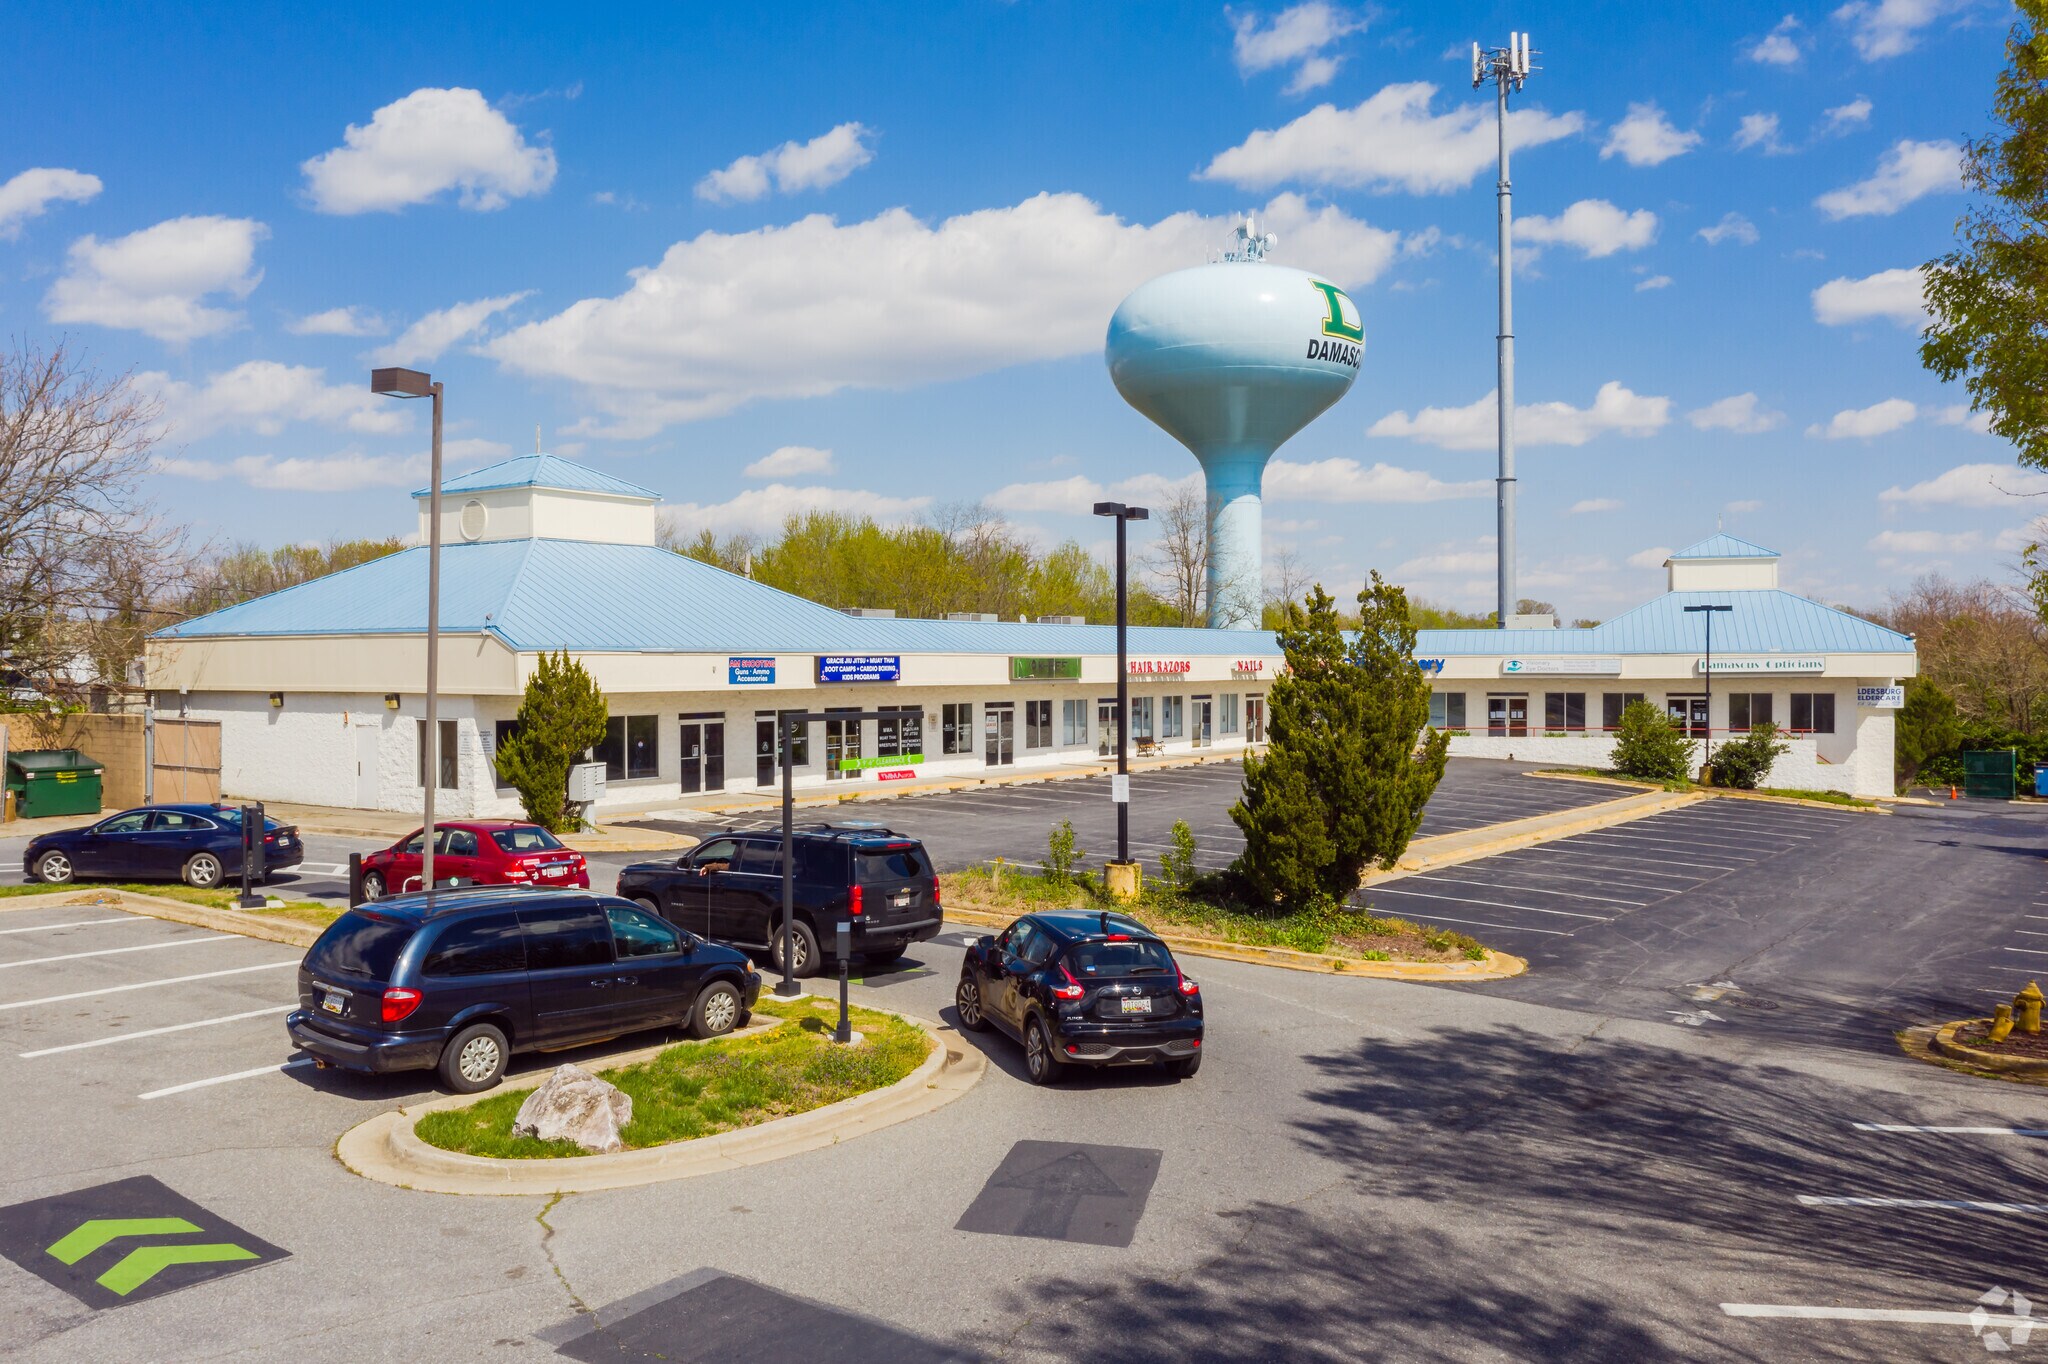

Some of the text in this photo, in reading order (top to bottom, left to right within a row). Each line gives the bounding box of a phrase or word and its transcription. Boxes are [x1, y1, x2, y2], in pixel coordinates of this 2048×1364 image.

[1306, 338, 1362, 370] DAMASC
[1130, 660, 1191, 673] HAIR RAZORS
[1237, 660, 1263, 671] NAILS
[1765, 660, 1823, 669] Opticians
